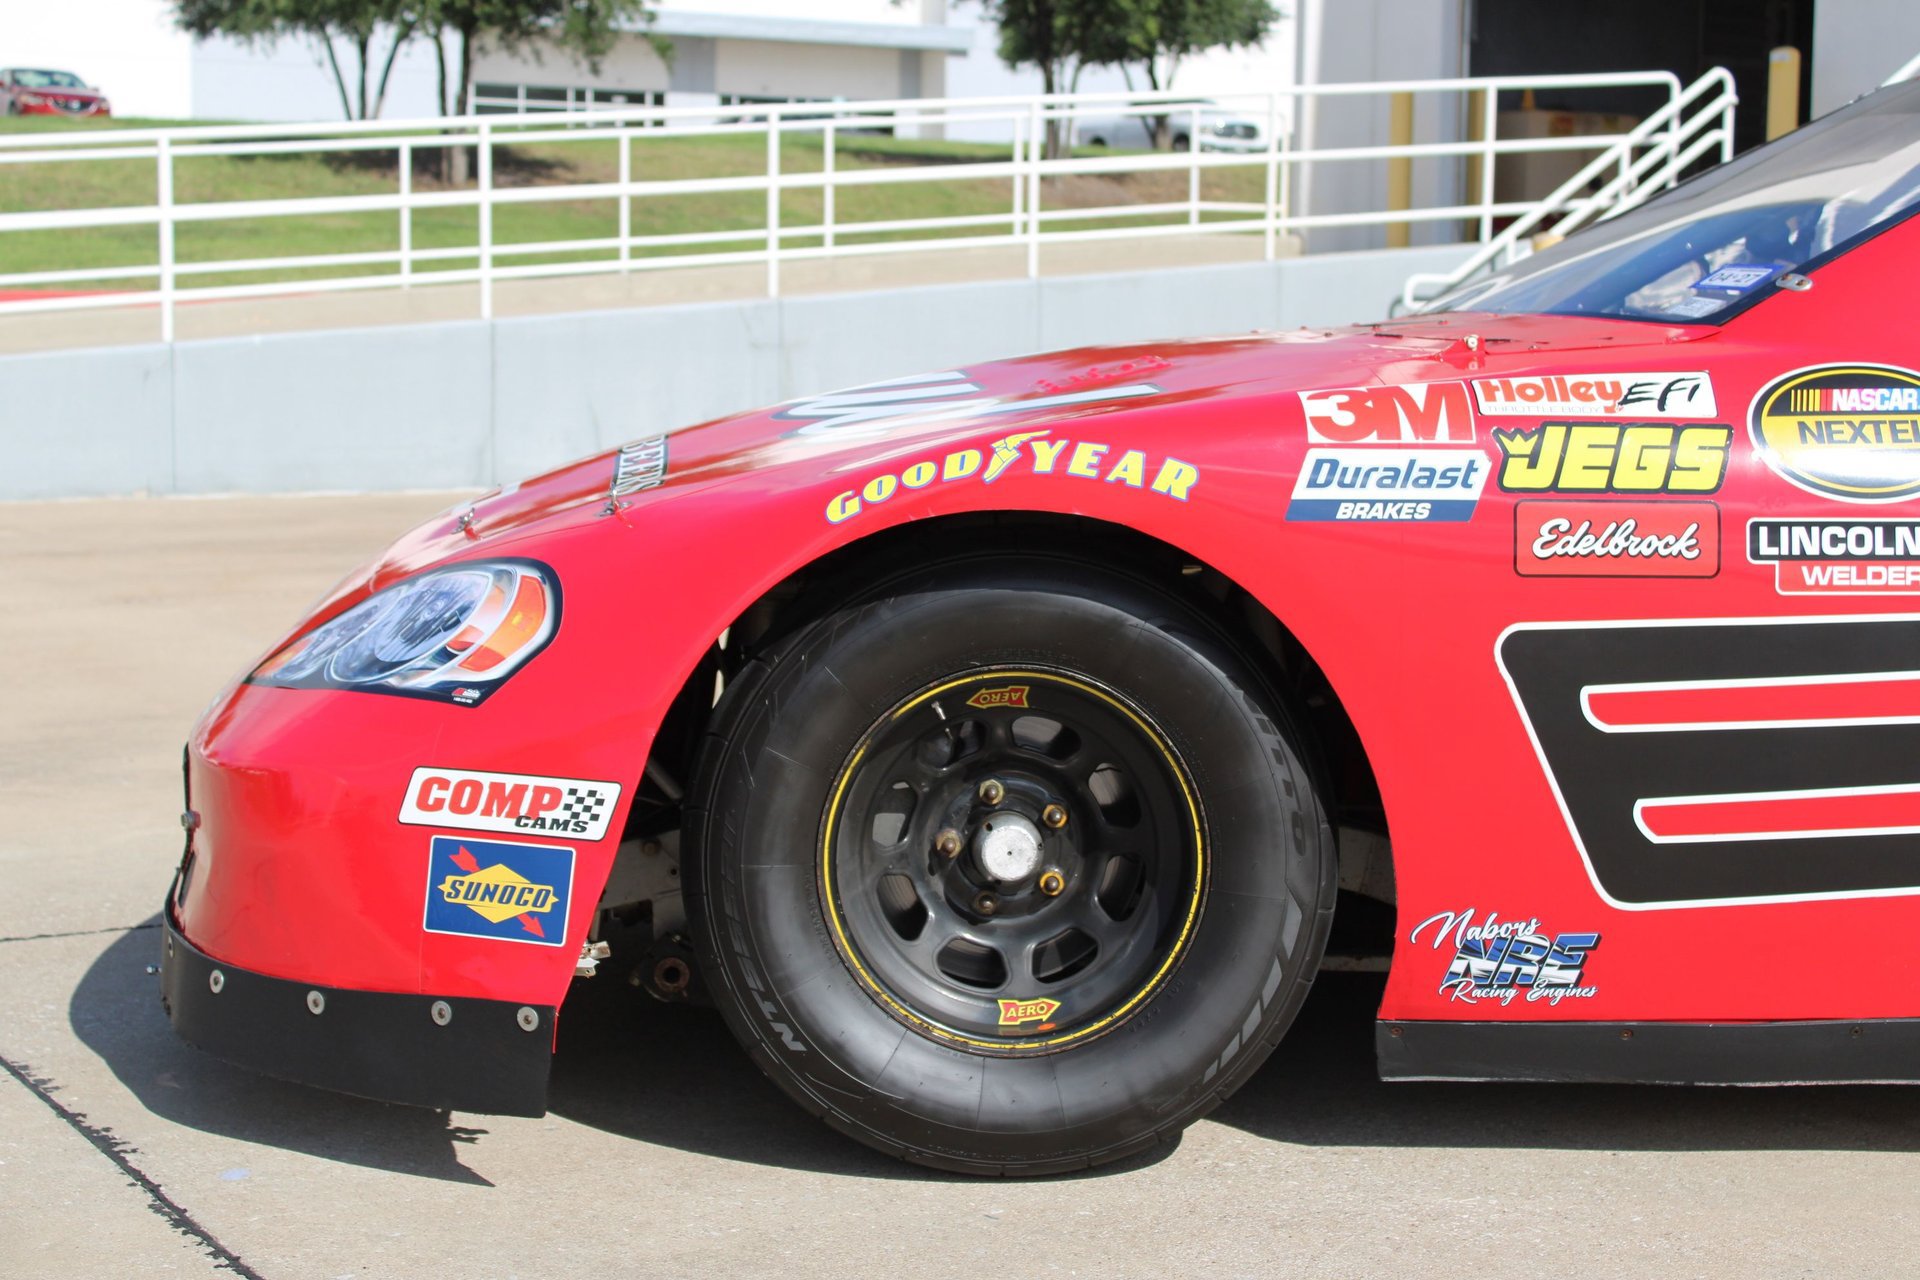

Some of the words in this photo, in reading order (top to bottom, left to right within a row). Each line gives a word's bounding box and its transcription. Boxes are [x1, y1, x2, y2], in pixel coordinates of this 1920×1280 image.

[1478, 376, 1623, 413] Holley
[1616, 377, 1702, 412] EFI
[1306, 383, 1474, 442] 3M
[1501, 425, 1729, 490] JEGS
[1305, 458, 1479, 489] Duralast
[1335, 502, 1432, 520] BRAKES
[1532, 517, 1700, 560] Edelbrock
[1758, 526, 1920, 556] LINCOLN
[979, 691, 1022, 704] AERO
[415, 776, 564, 820] COMP
[514, 815, 590, 834] CAMS
[445, 879, 552, 909] SUNOCO
[1409, 907, 1542, 950] Nabors
[1441, 932, 1602, 989] NRE
[1438, 977, 1520, 1007] Racing
[1525, 977, 1599, 1007] Engines
[1005, 1003, 1048, 1019] AERO
